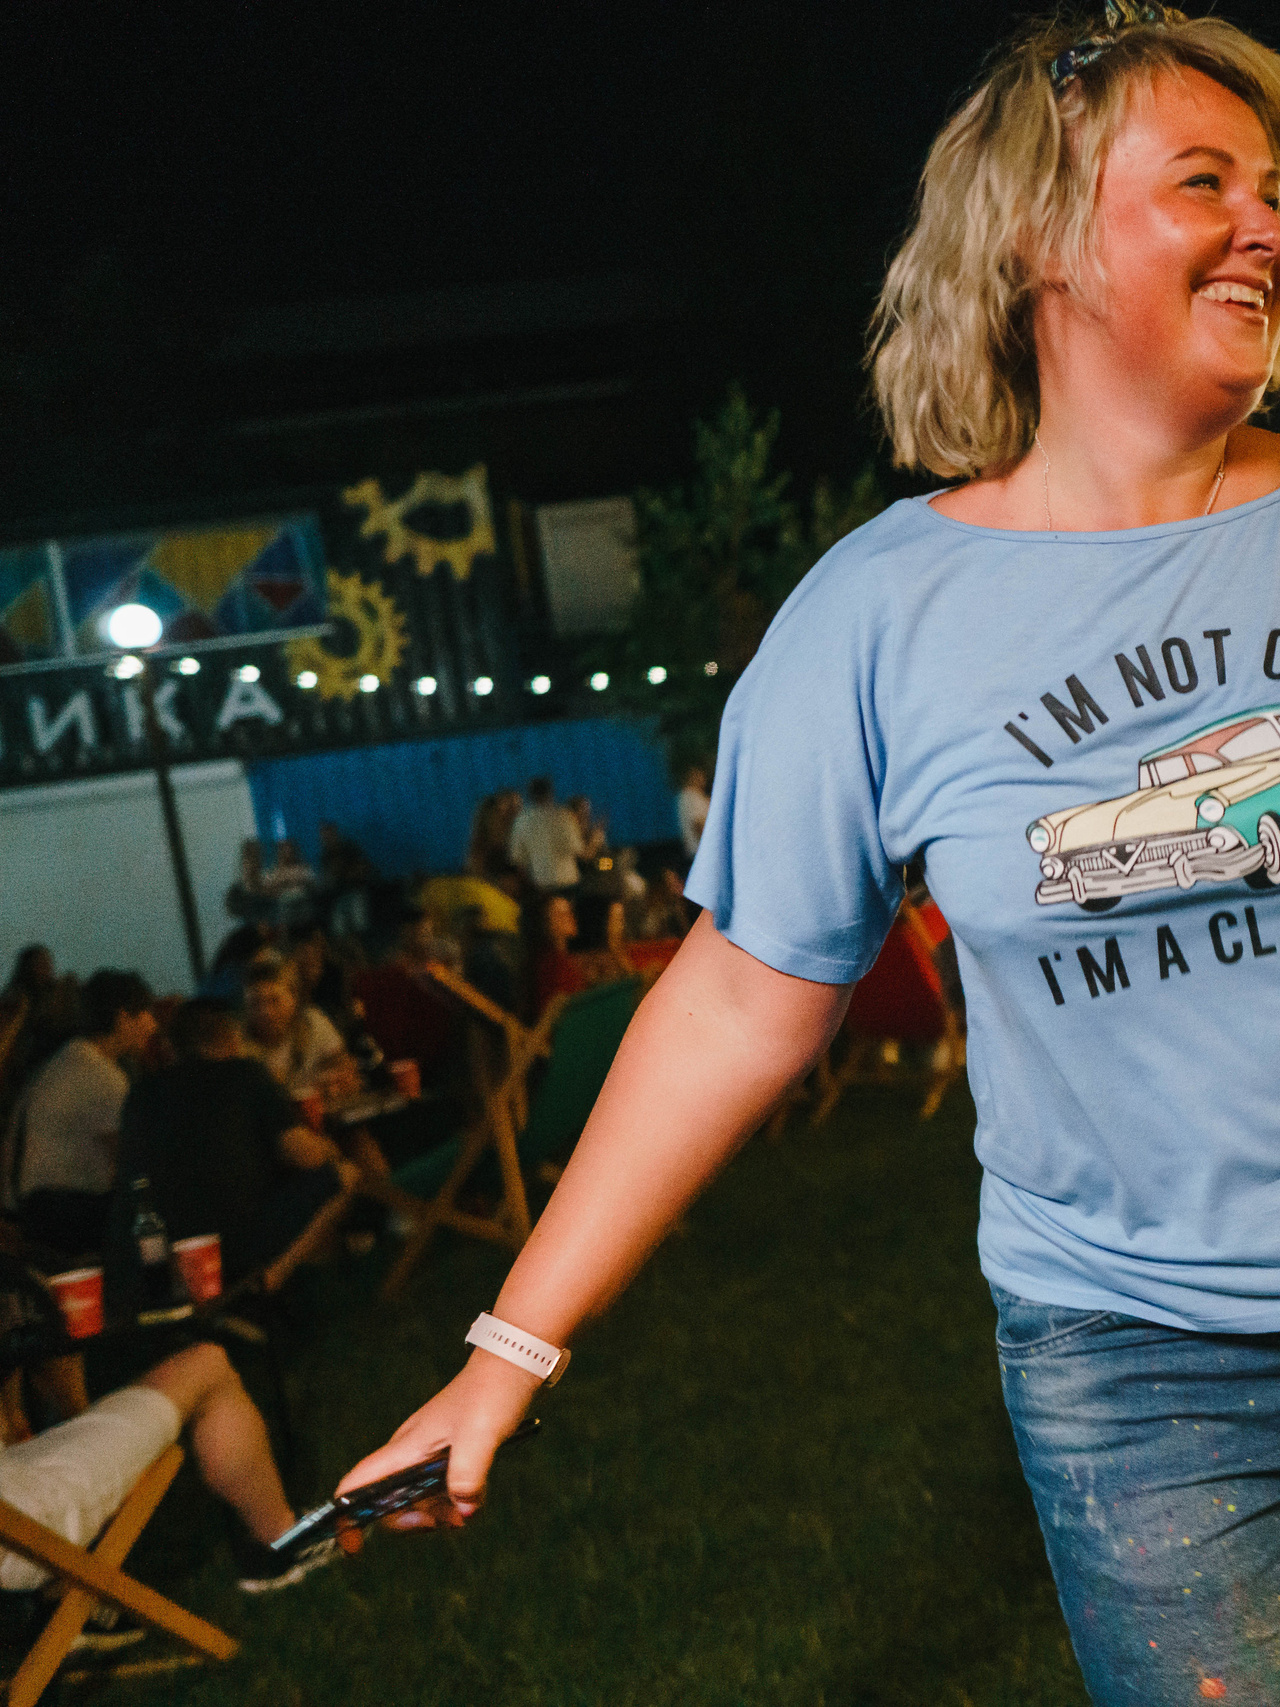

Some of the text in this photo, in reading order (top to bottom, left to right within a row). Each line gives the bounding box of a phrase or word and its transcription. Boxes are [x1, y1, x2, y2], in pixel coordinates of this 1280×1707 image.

[0, 671, 285, 758] ИКА
[1004, 674, 1109, 768] I'M
[1115, 628, 1231, 707] NOT
[1038, 935, 1131, 1006] I'M
[1157, 924, 1191, 981] A
